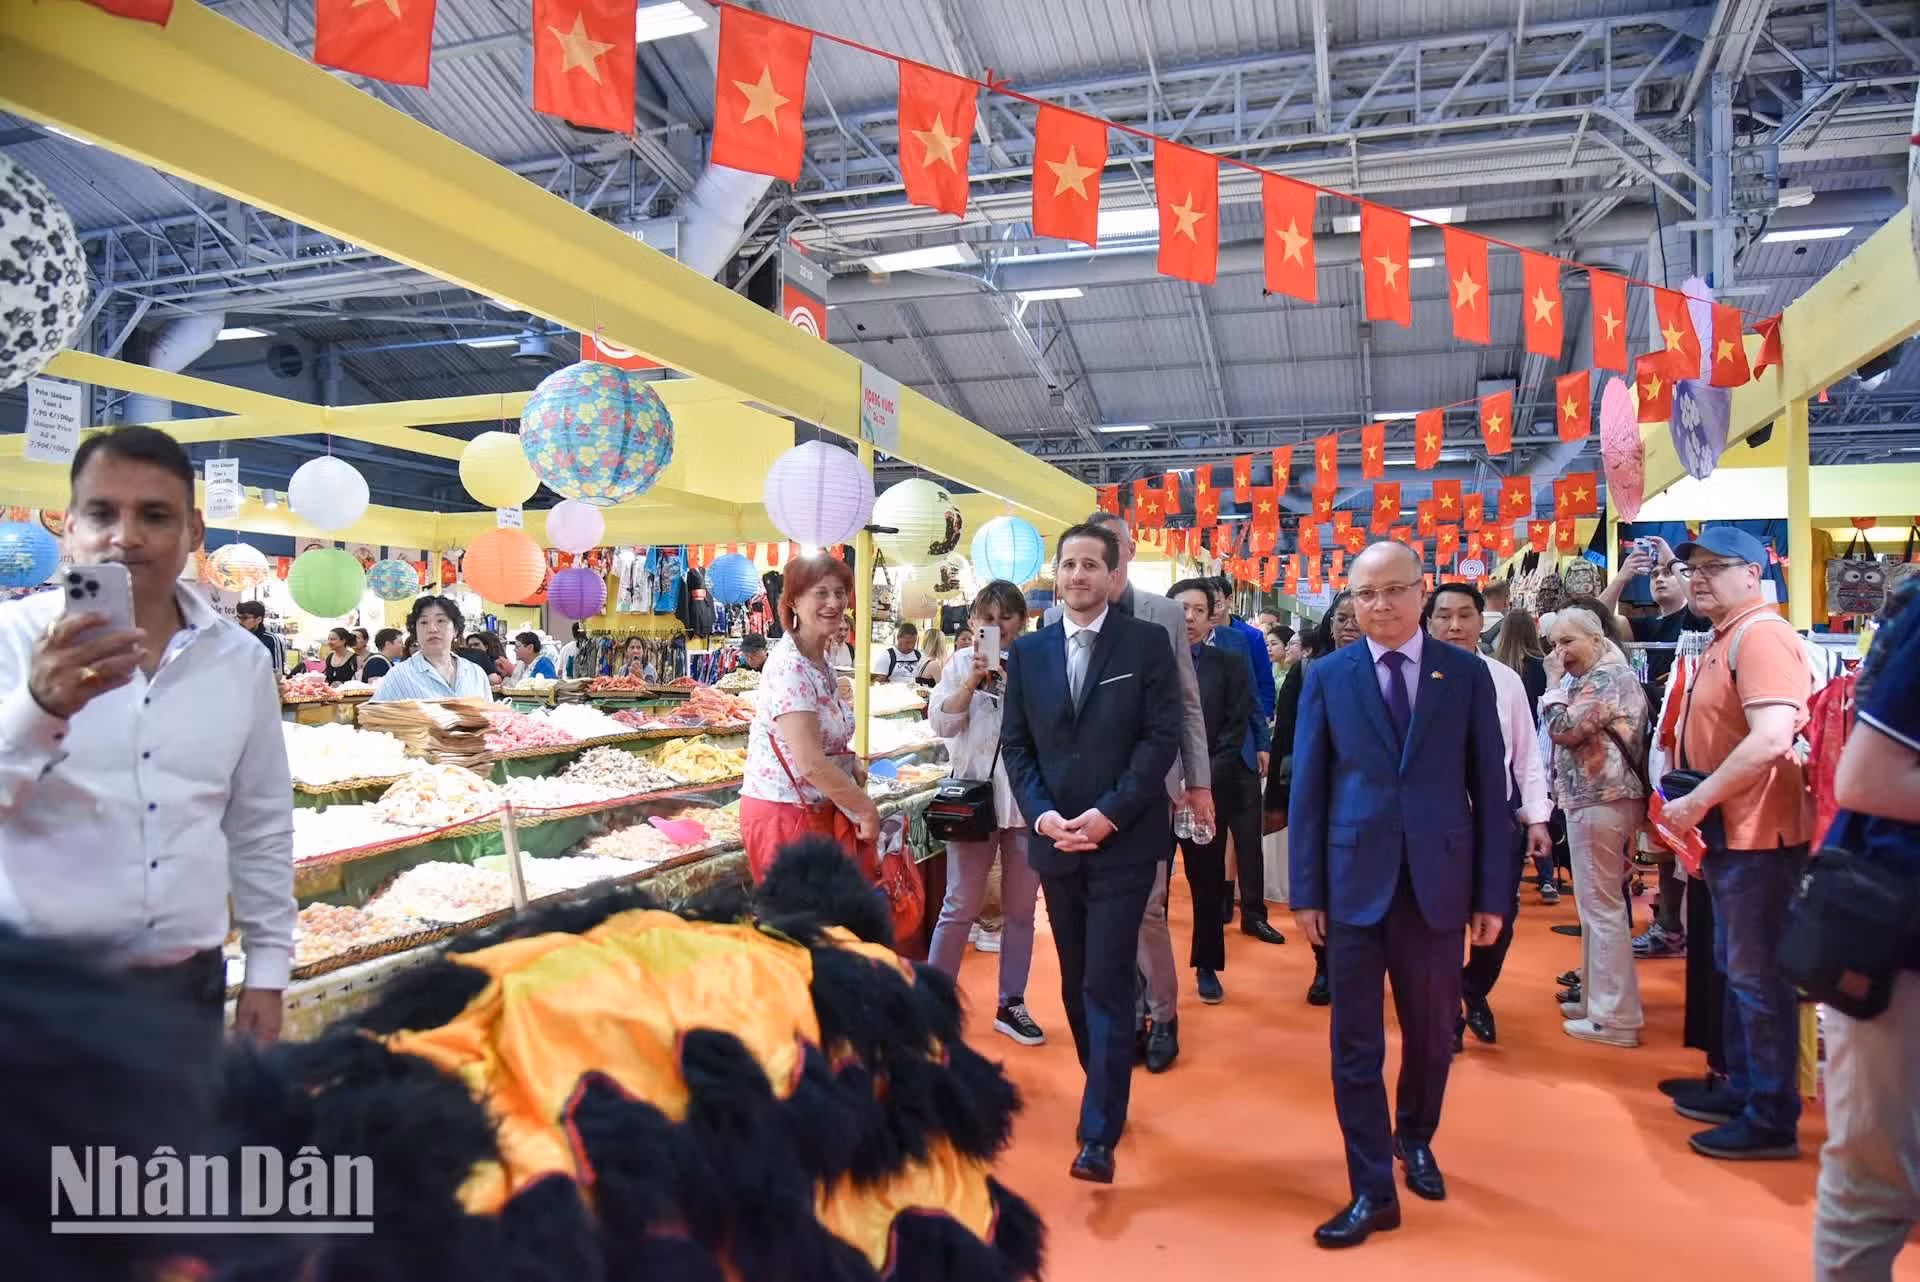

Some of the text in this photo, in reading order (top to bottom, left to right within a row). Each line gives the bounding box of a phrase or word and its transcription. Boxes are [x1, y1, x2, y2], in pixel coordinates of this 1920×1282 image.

[35, 388, 72, 400] Prix Unique
[224, 606, 235, 614] tea
